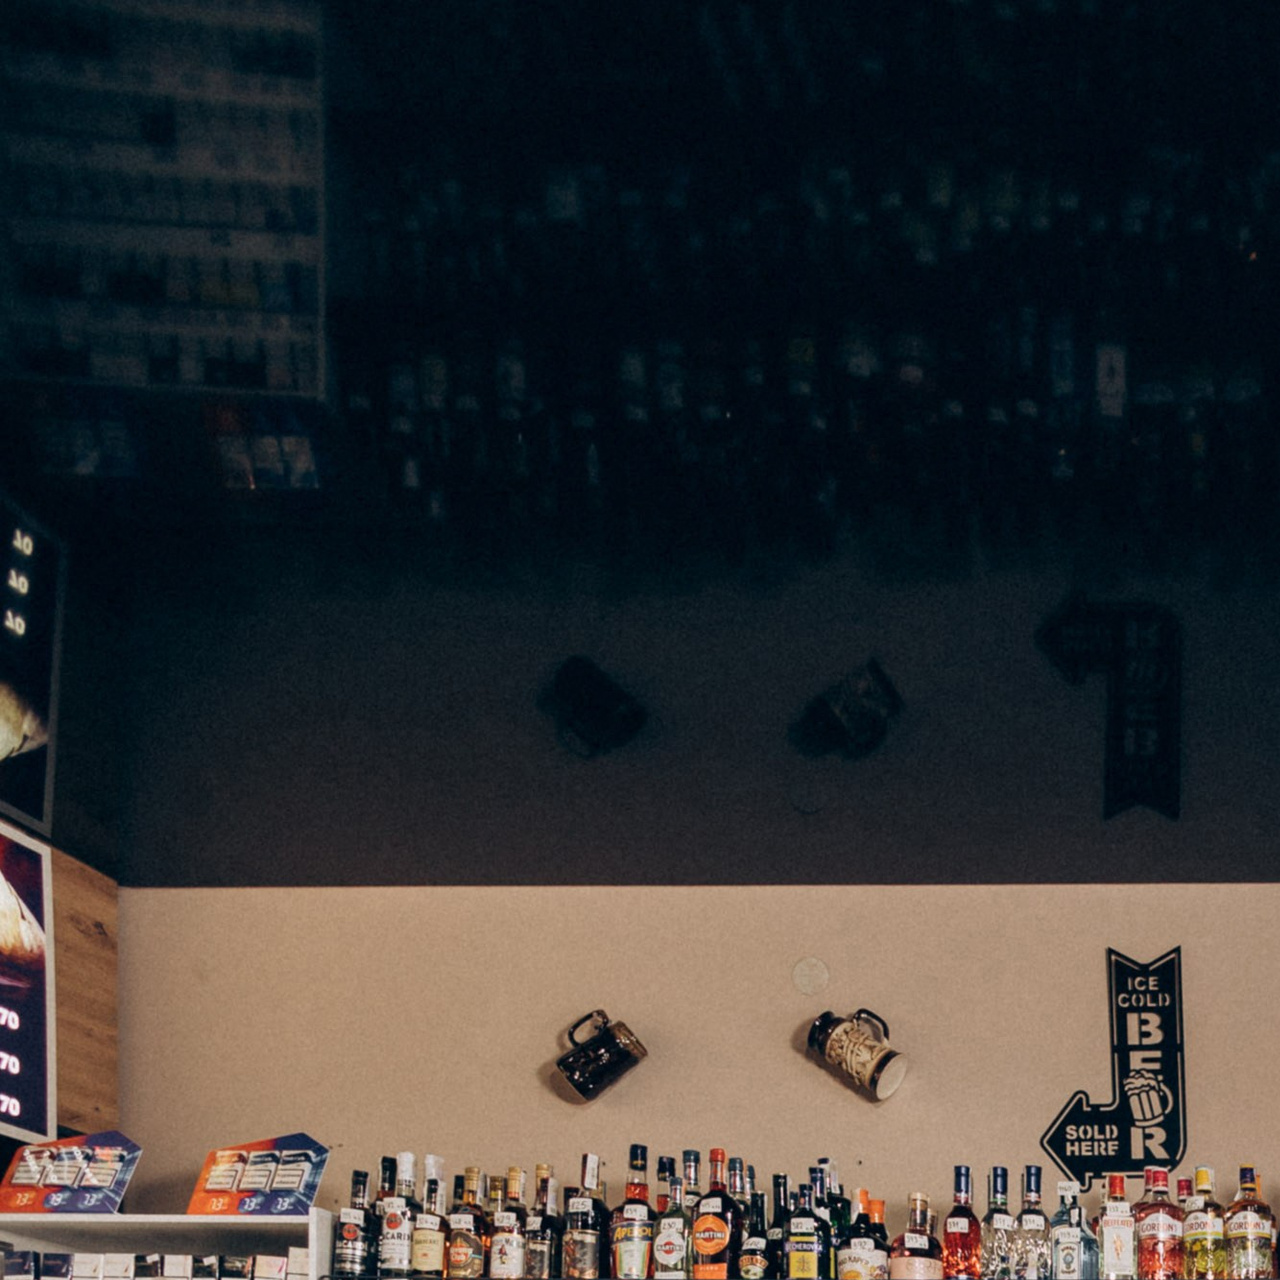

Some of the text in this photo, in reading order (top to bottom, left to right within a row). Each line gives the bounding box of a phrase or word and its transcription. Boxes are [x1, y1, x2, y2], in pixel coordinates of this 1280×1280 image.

[1128, 976, 1159, 991] ICE
[1118, 993, 1170, 1008] COLD
[1126, 1011, 1171, 1160] BER
[1065, 1124, 1118, 1140] SOLD
[1065, 1141, 1119, 1156] HERE
[614, 1225, 653, 1241] APEROL
[695, 1230, 726, 1240] MARTINI
